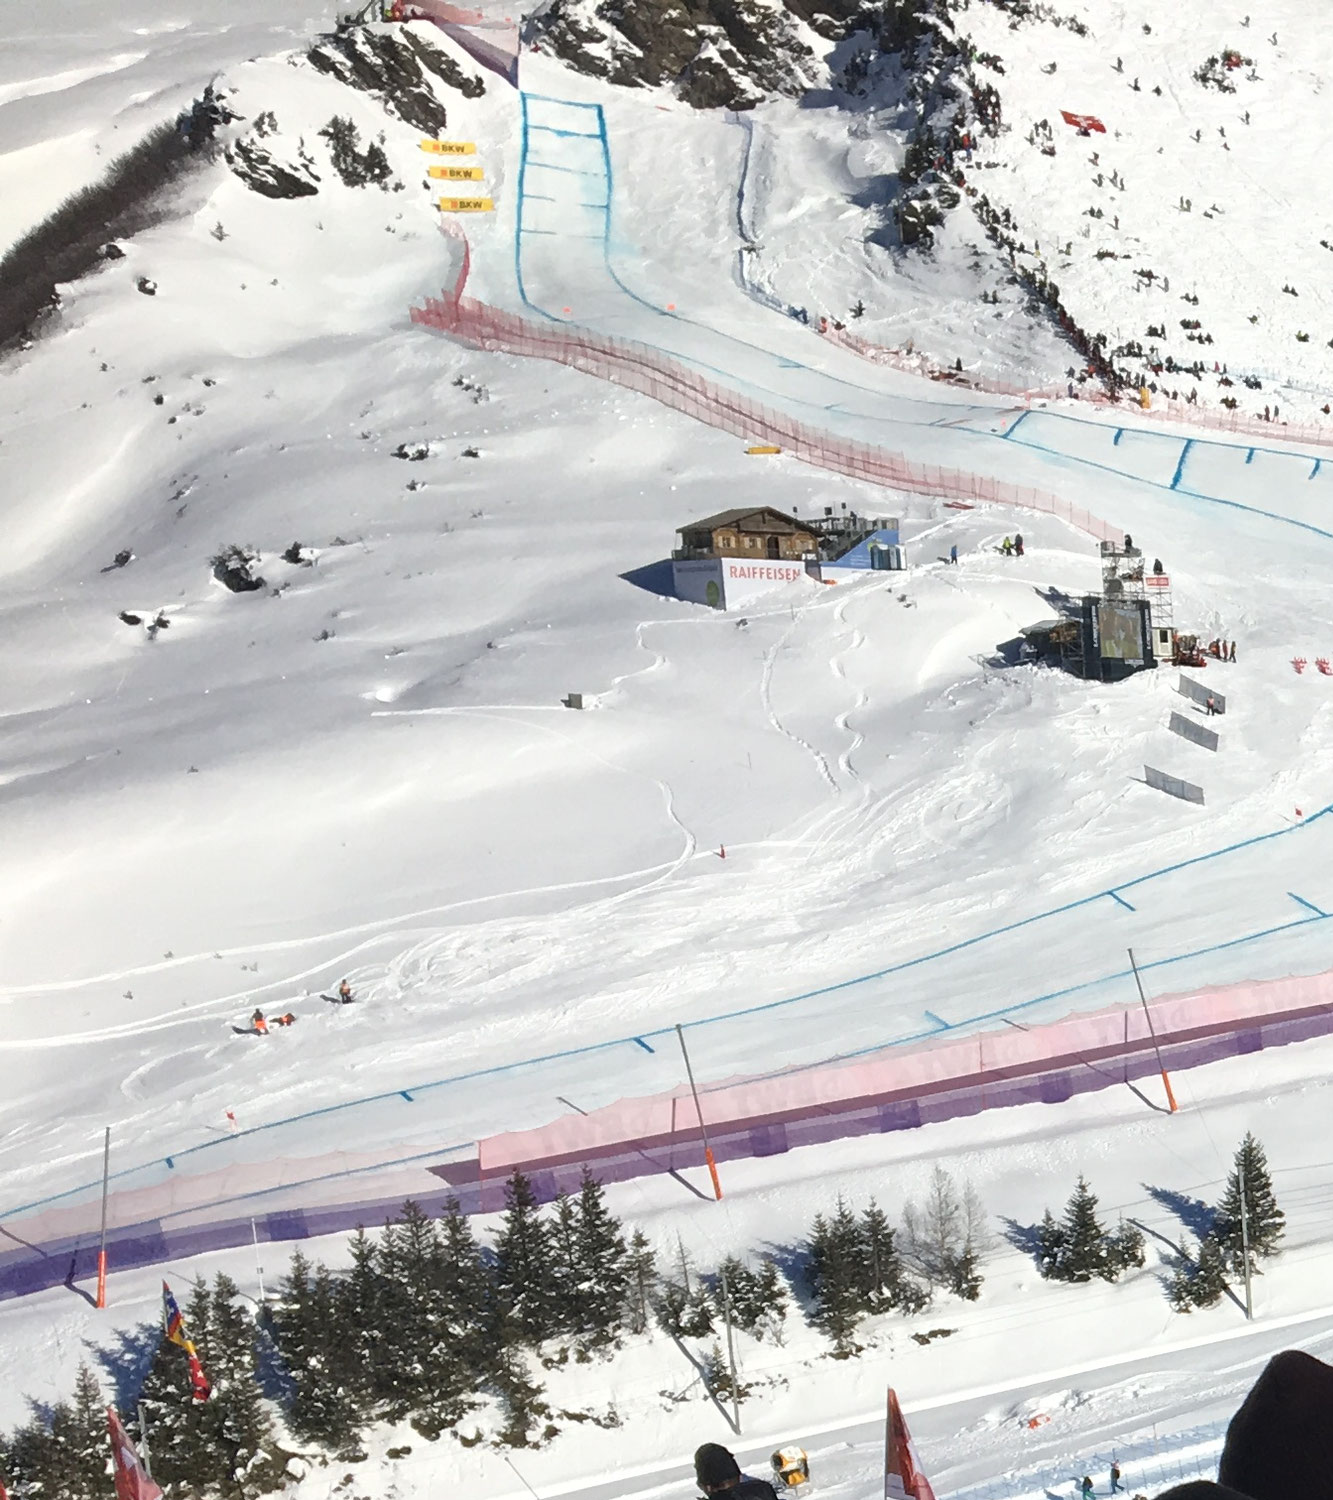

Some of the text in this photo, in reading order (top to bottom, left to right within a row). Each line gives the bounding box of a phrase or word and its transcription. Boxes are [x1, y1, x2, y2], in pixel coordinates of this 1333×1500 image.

[442, 144, 465, 153] BKW
[449, 169, 473, 178] BKW
[459, 201, 482, 209] BKW
[729, 565, 801, 581] RAIFFEISEN
